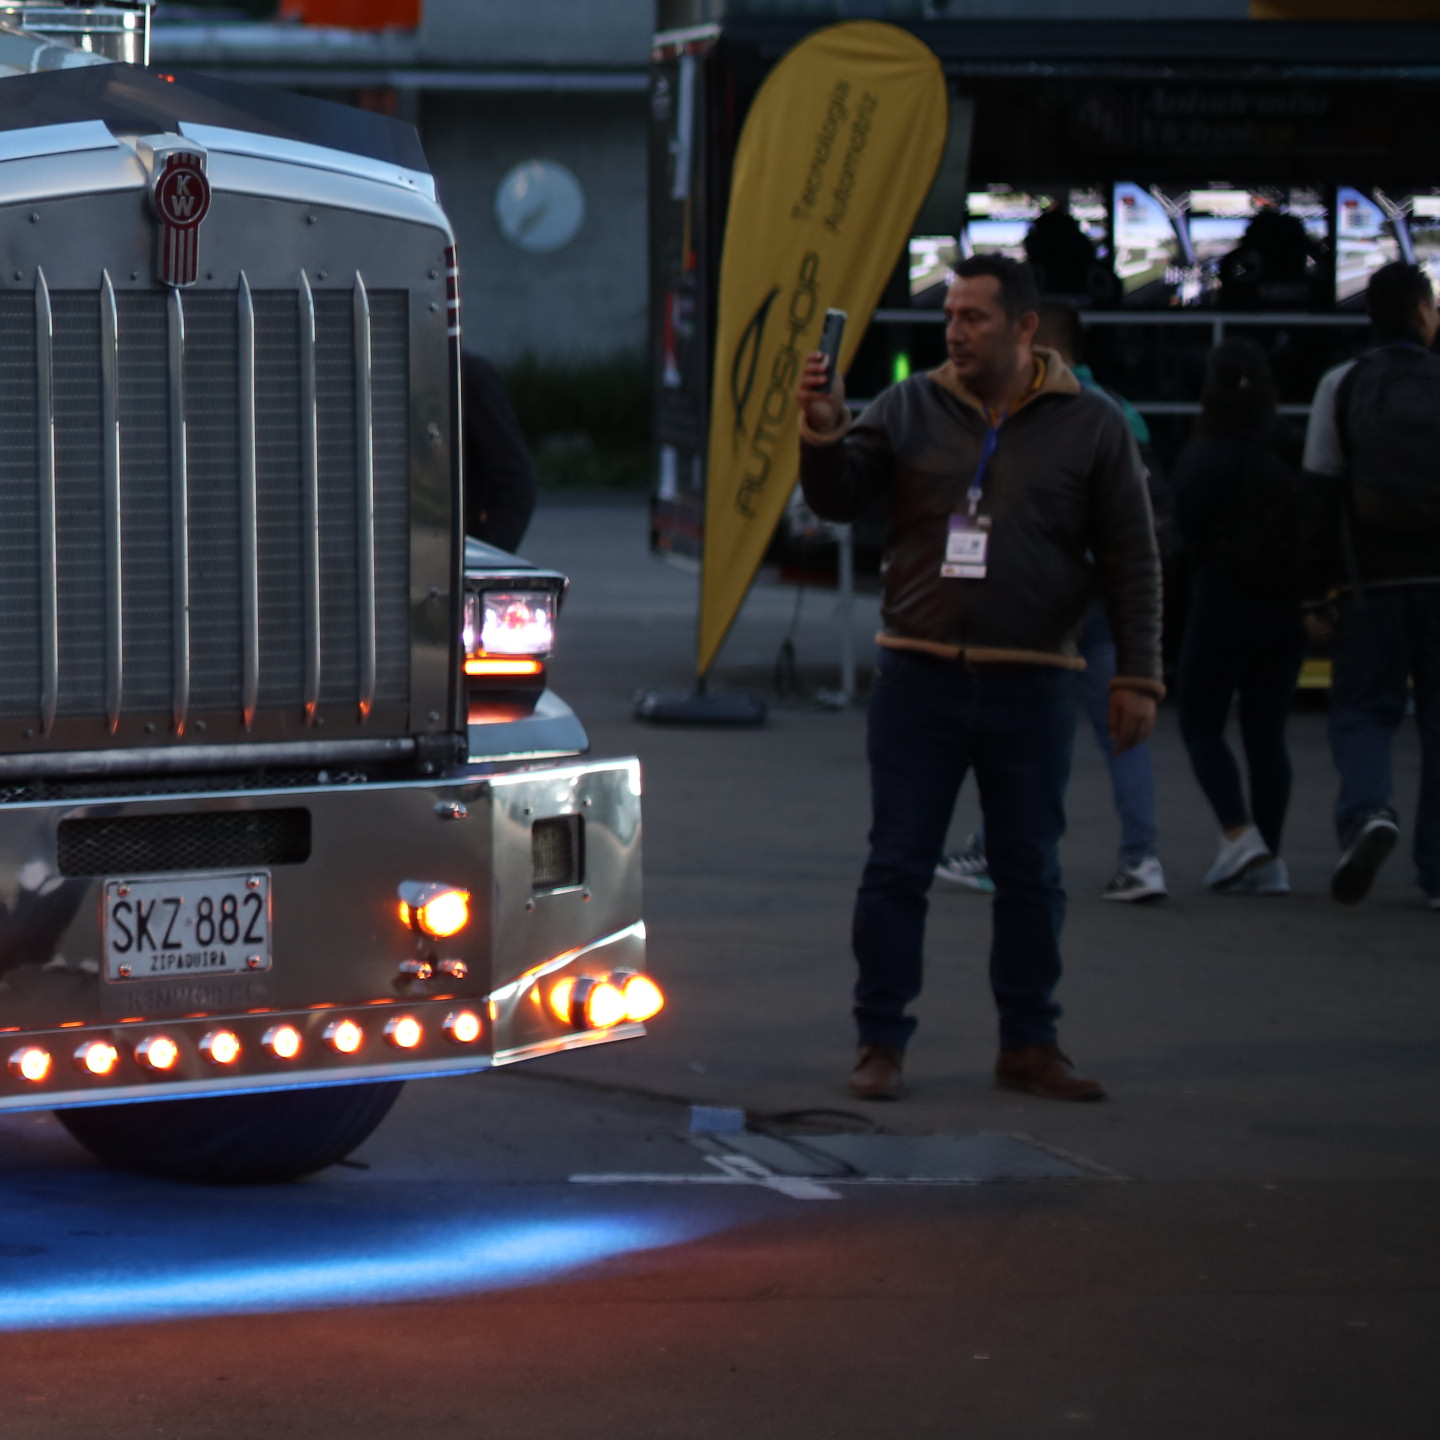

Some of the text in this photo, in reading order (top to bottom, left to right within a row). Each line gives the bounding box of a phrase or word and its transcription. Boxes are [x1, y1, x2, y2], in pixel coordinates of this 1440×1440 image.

[735, 250, 821, 520] AUTOSHOP
[111, 891, 265, 953] SKZ 882
